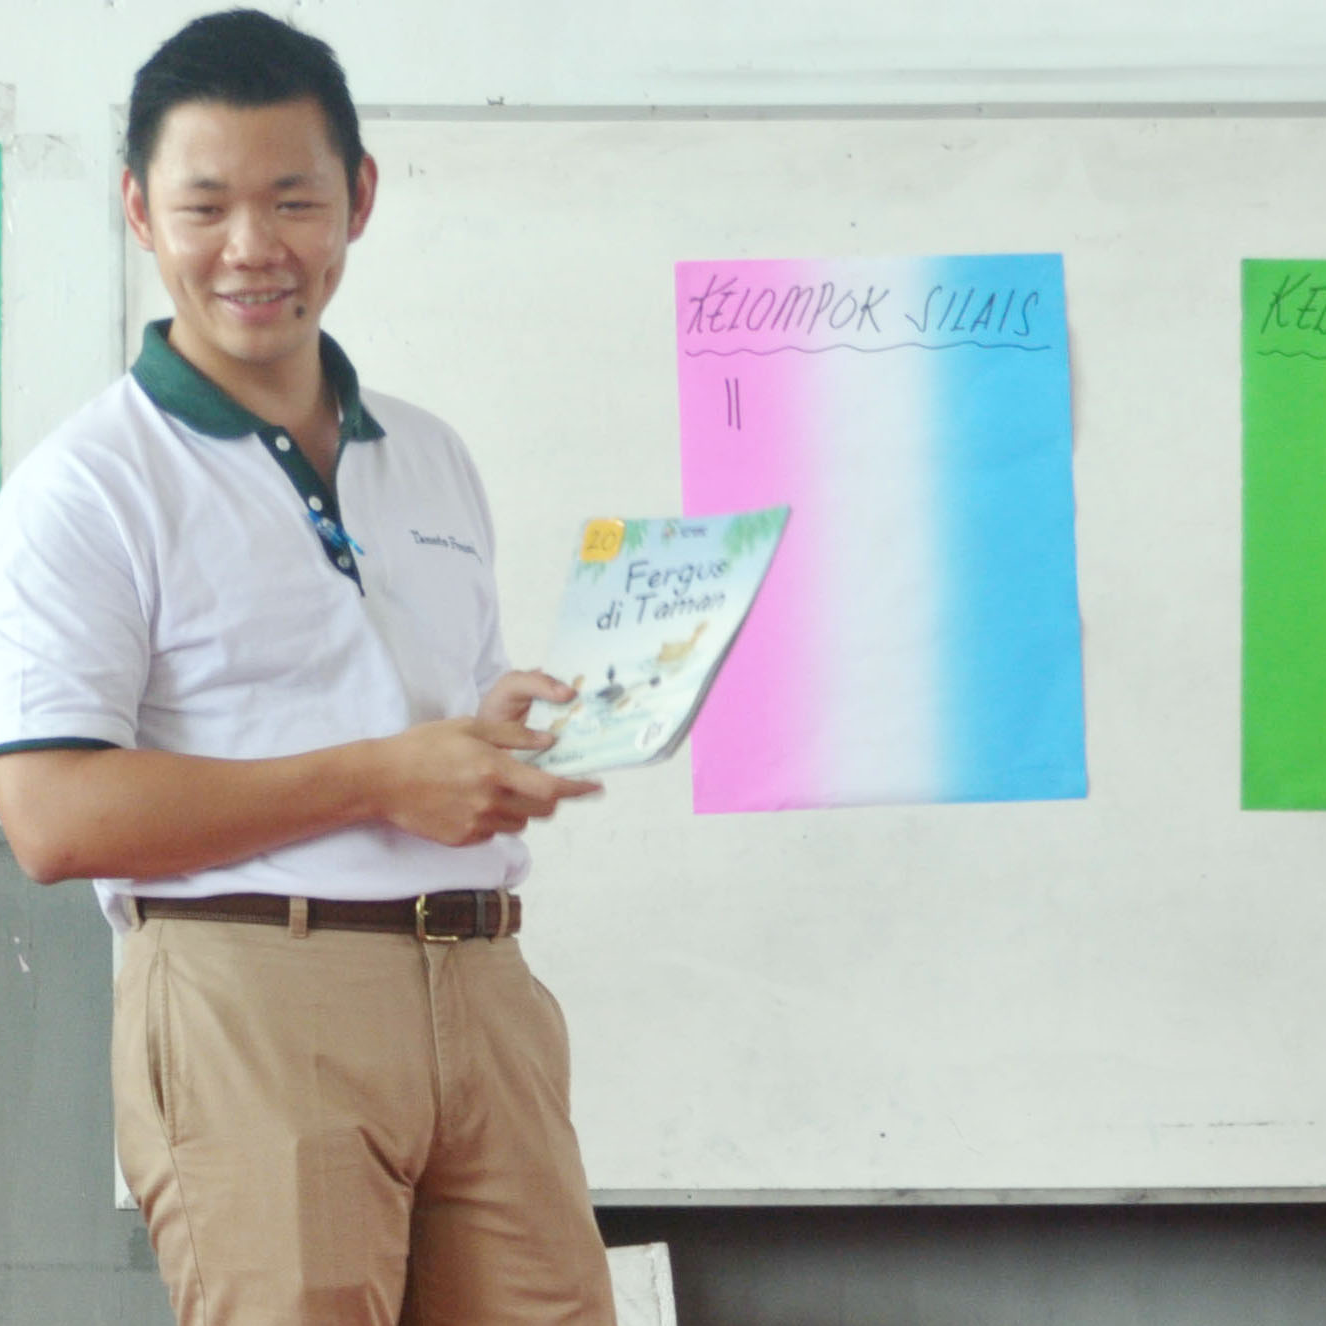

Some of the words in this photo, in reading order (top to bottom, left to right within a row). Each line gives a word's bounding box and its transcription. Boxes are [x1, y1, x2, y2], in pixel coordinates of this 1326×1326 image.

[687, 274, 890, 335] KELOMPOK
[626, 560, 730, 597] Fergus
[596, 600, 623, 630] di
[636, 592, 726, 624] Taman
